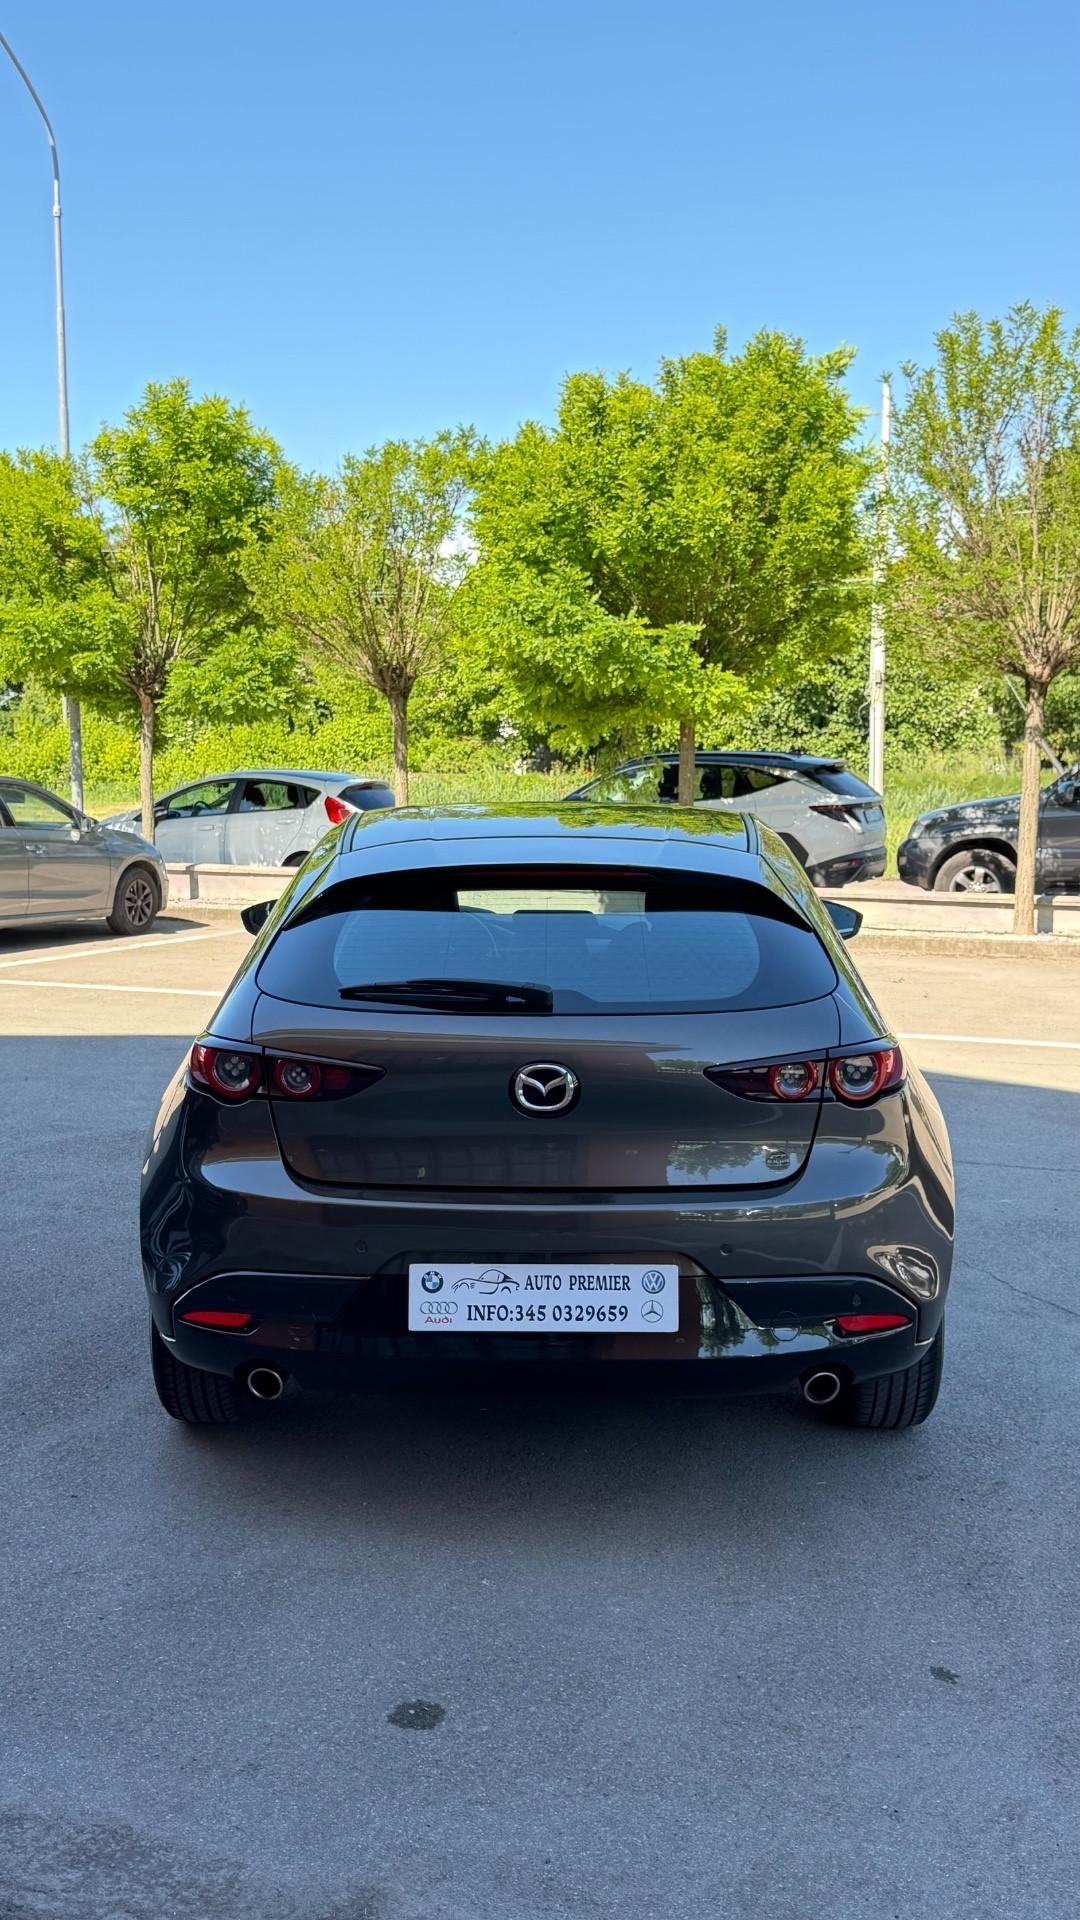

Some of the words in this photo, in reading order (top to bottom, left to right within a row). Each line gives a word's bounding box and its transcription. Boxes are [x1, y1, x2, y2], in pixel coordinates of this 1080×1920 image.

[524, 1274, 562, 1291] AUTO
[568, 1274, 632, 1291] PREMIER
[424, 1315, 453, 1324] Audi
[466, 1304, 546, 1322] INFO:345
[552, 1304, 629, 1322] 0329659
